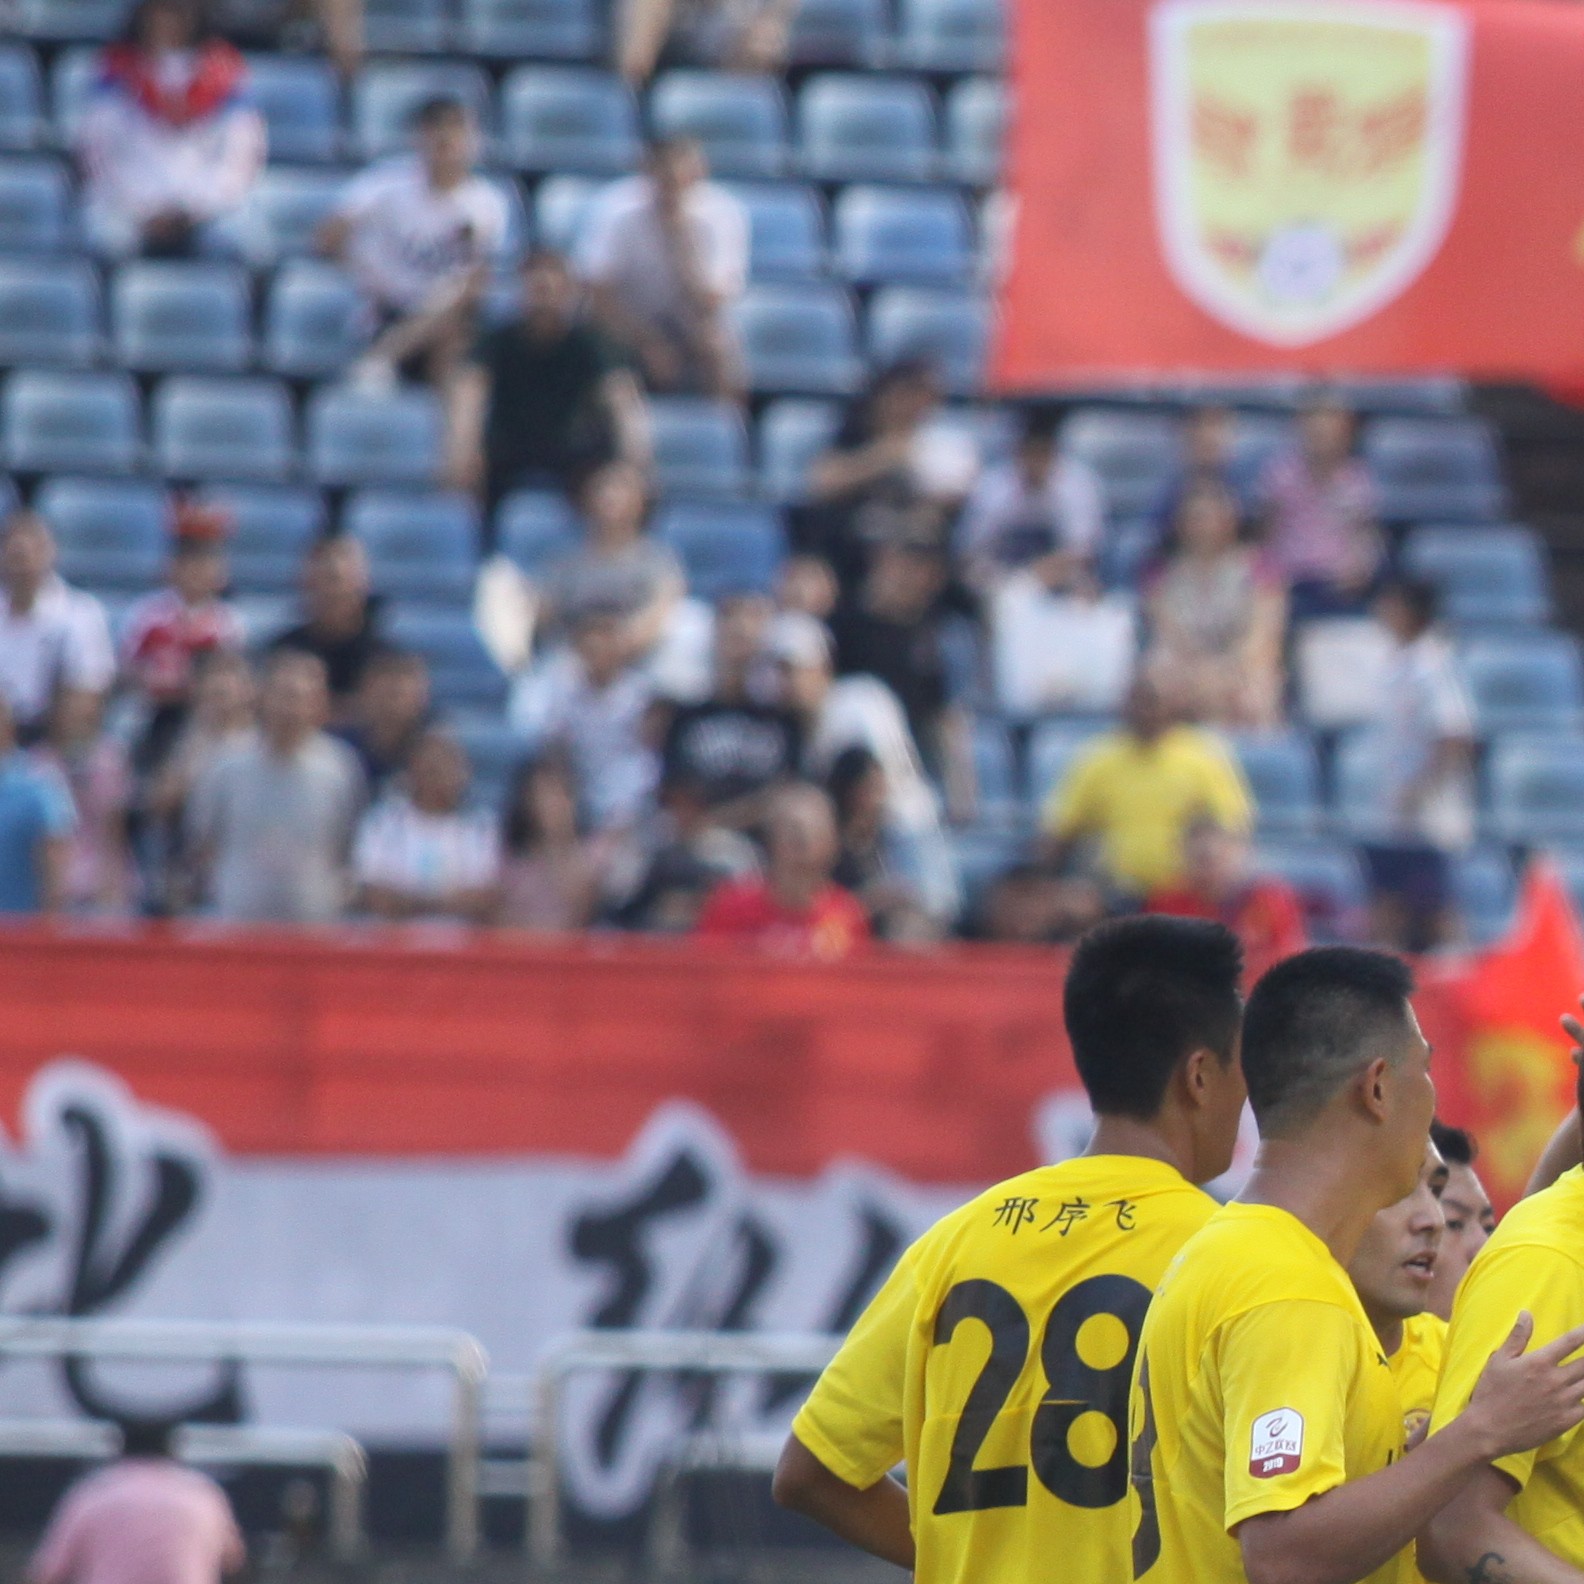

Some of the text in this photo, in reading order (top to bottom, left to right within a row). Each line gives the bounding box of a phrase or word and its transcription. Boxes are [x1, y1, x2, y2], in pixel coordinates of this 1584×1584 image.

[992, 1196, 1137, 1237] 邢序飞
[932, 1273, 1157, 1515] 28
